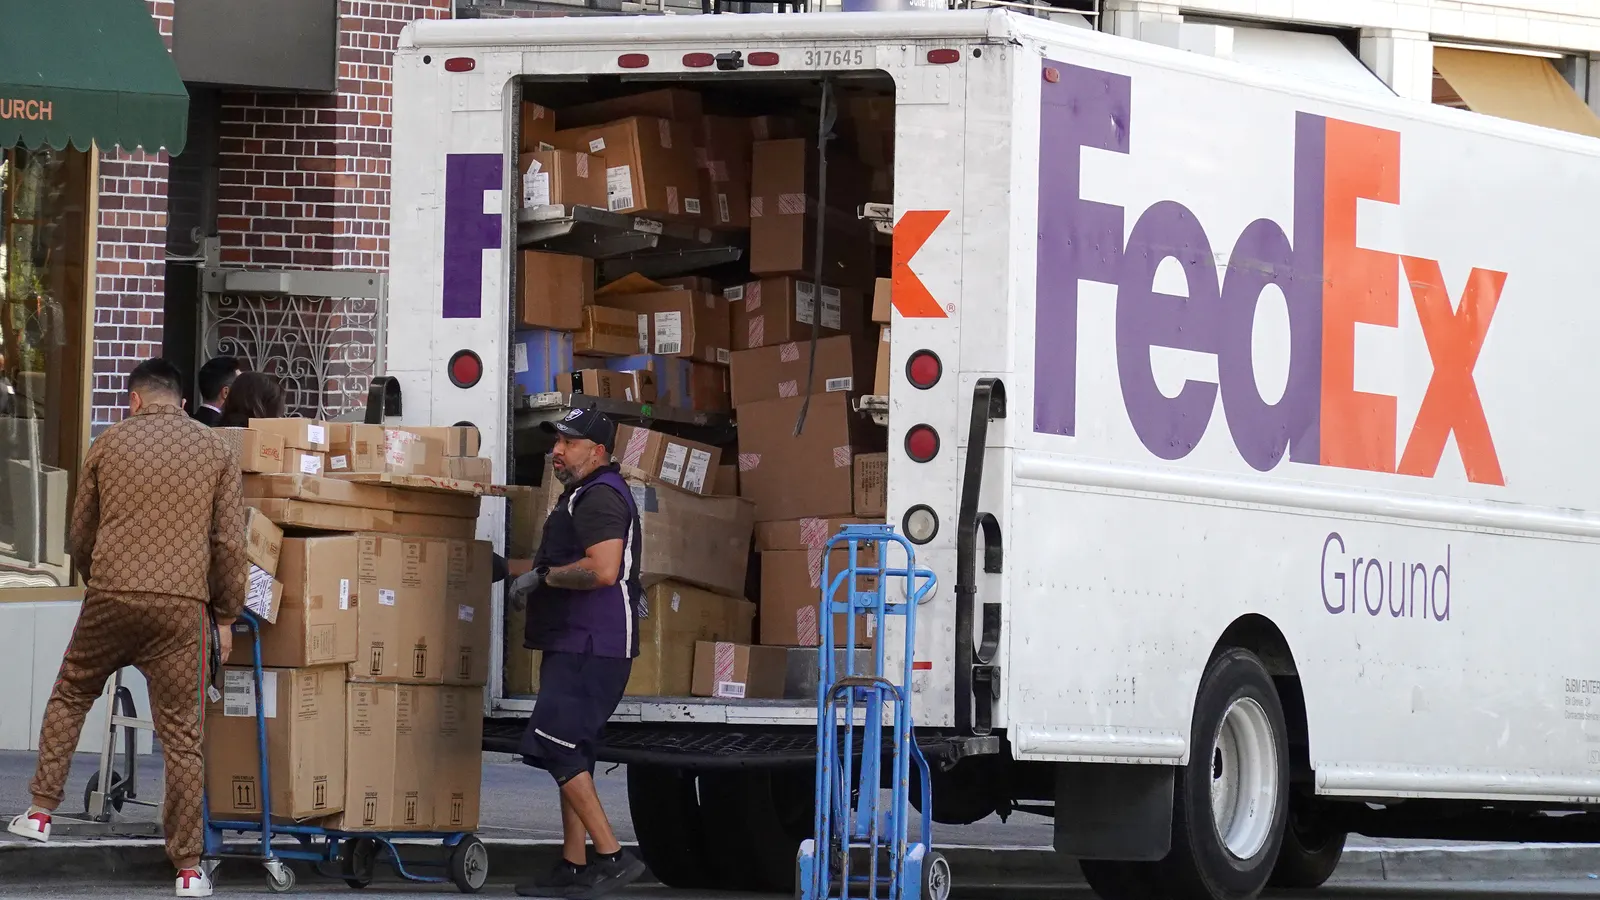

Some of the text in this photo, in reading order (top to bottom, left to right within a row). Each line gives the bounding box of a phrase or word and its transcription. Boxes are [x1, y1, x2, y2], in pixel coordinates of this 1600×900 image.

[805, 50, 863, 66] 317645
[0, 98, 52, 120] URCH
[1033, 58, 1508, 486] FedEx
[1320, 531, 1451, 622] Ground
